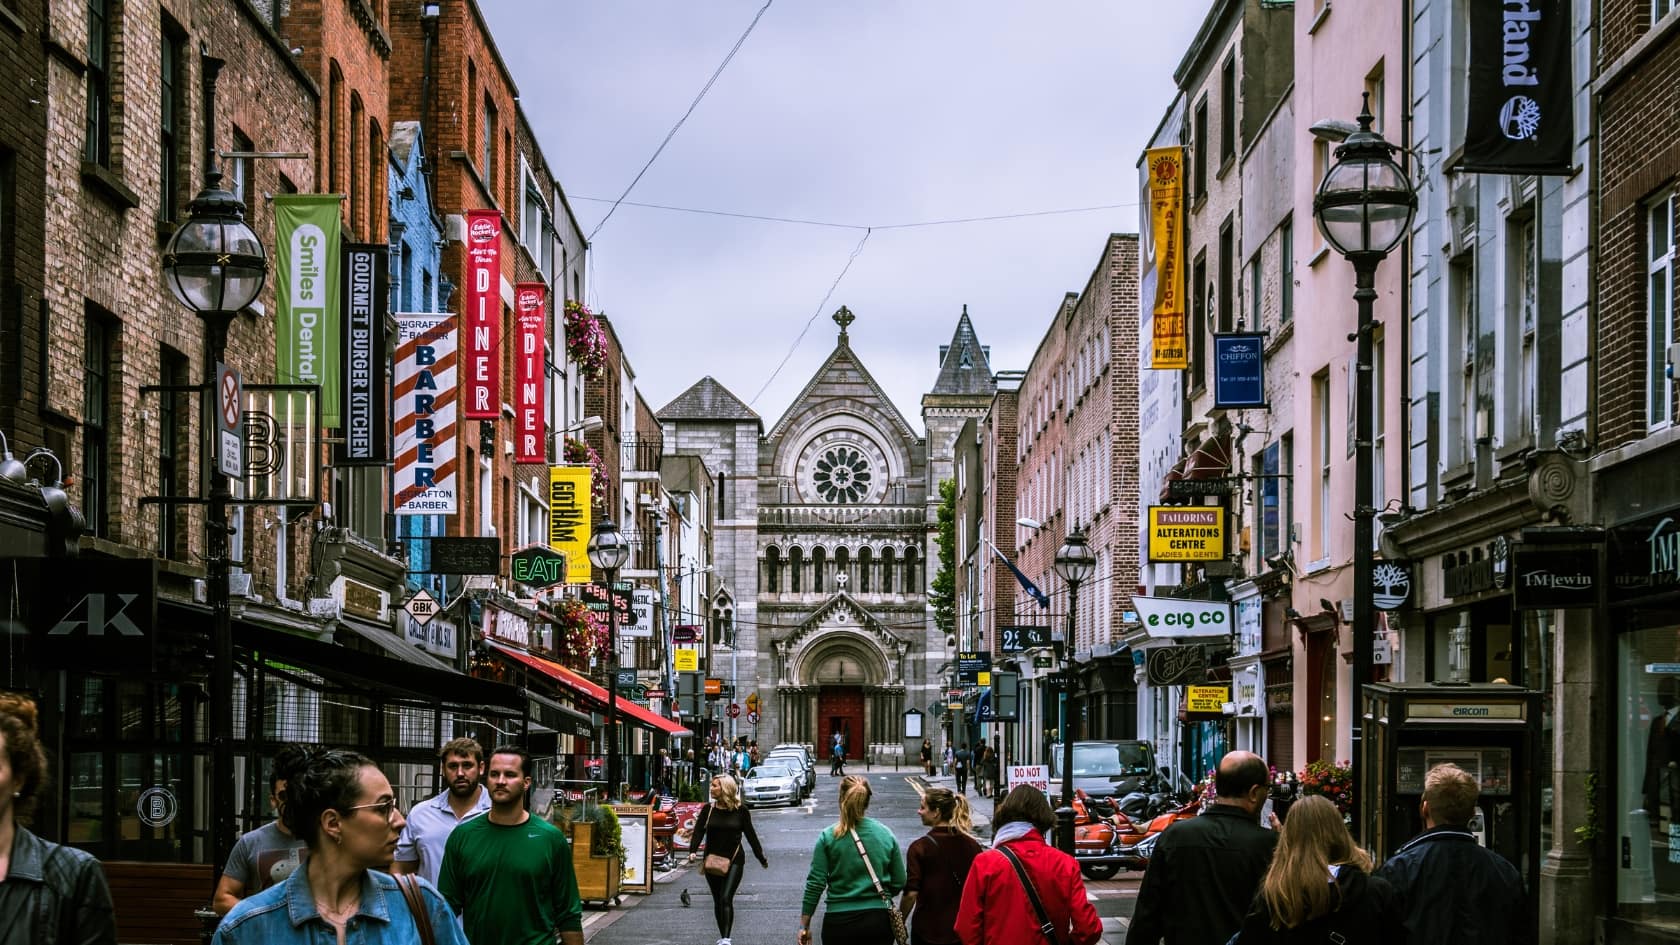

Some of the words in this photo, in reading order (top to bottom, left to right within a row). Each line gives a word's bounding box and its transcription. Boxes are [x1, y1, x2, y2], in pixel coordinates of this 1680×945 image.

[299, 234, 318, 301] Smiles
[1163, 210, 1175, 309] ALTERATION
[353, 252, 370, 325] GOURMET
[399, 320, 408, 338] THE
[408, 320, 452, 329] GRAFTON
[409, 331, 449, 340] BARBER
[1155, 316, 1183, 334] CENTRE
[298, 312, 318, 384] Dental
[474, 268, 490, 410] DINER
[352, 329, 369, 387] BURGER
[1220, 352, 1257, 360] CHIFFON
[523, 333, 537, 456] DINER
[352, 392, 368, 457] KITCHEN
[414, 345, 437, 488] BARBER
[408, 501, 448, 509] BARBER
[551, 481, 586, 542] GOTHAM
[1161, 513, 1214, 523] TAILORING
[1157, 528, 1219, 538] ALTERATIONS
[1170, 540, 1206, 549] CENTRE
[514, 555, 562, 582] EAT
[48, 593, 145, 636] AK
[412, 602, 433, 613] GBK
[1148, 613, 1160, 627] e
[1164, 612, 1195, 629] cig
[1199, 610, 1225, 625] co
[1015, 768, 1025, 778] DO
[1027, 767, 1041, 777] NOT
[150, 795, 165, 819] B
